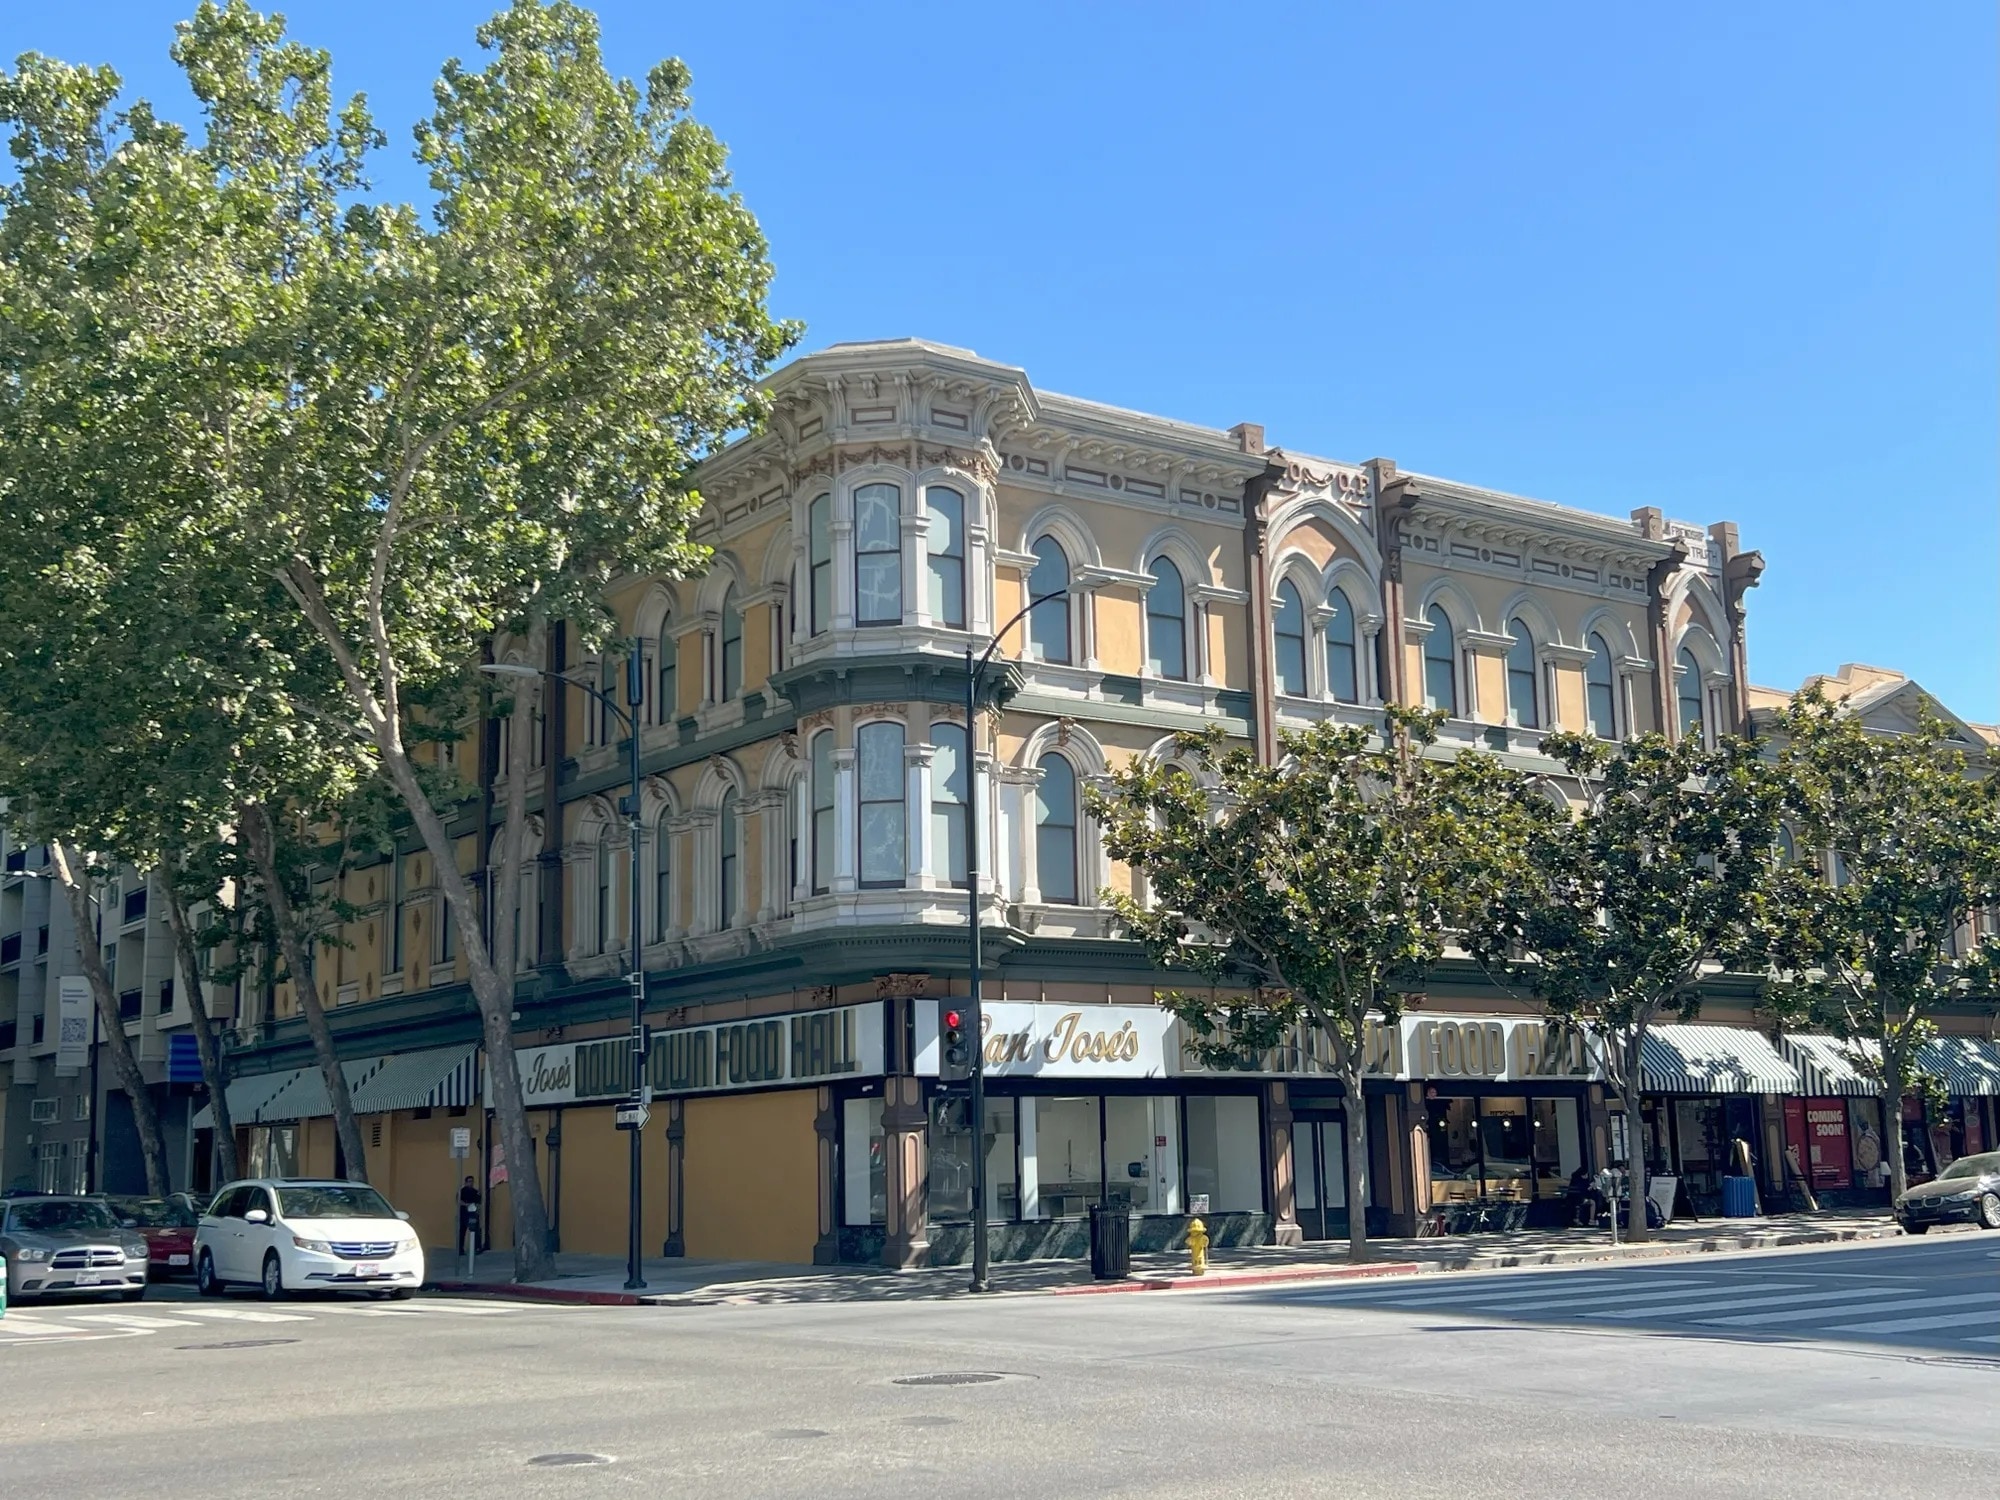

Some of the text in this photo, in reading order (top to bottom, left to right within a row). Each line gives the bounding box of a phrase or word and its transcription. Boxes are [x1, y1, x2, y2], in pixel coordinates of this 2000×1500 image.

[1690, 546, 1719, 564] TRUTH
[575, 1029, 715, 1098] DOWOWN
[716, 1020, 787, 1086] FOOD
[791, 1008, 863, 1079] HALL
[1419, 1020, 1506, 1076] FOOD
[1514, 1023, 1595, 1076] HALL
[1807, 1110, 1844, 1123] COMING
[1816, 1123, 1844, 1136] SOON!
